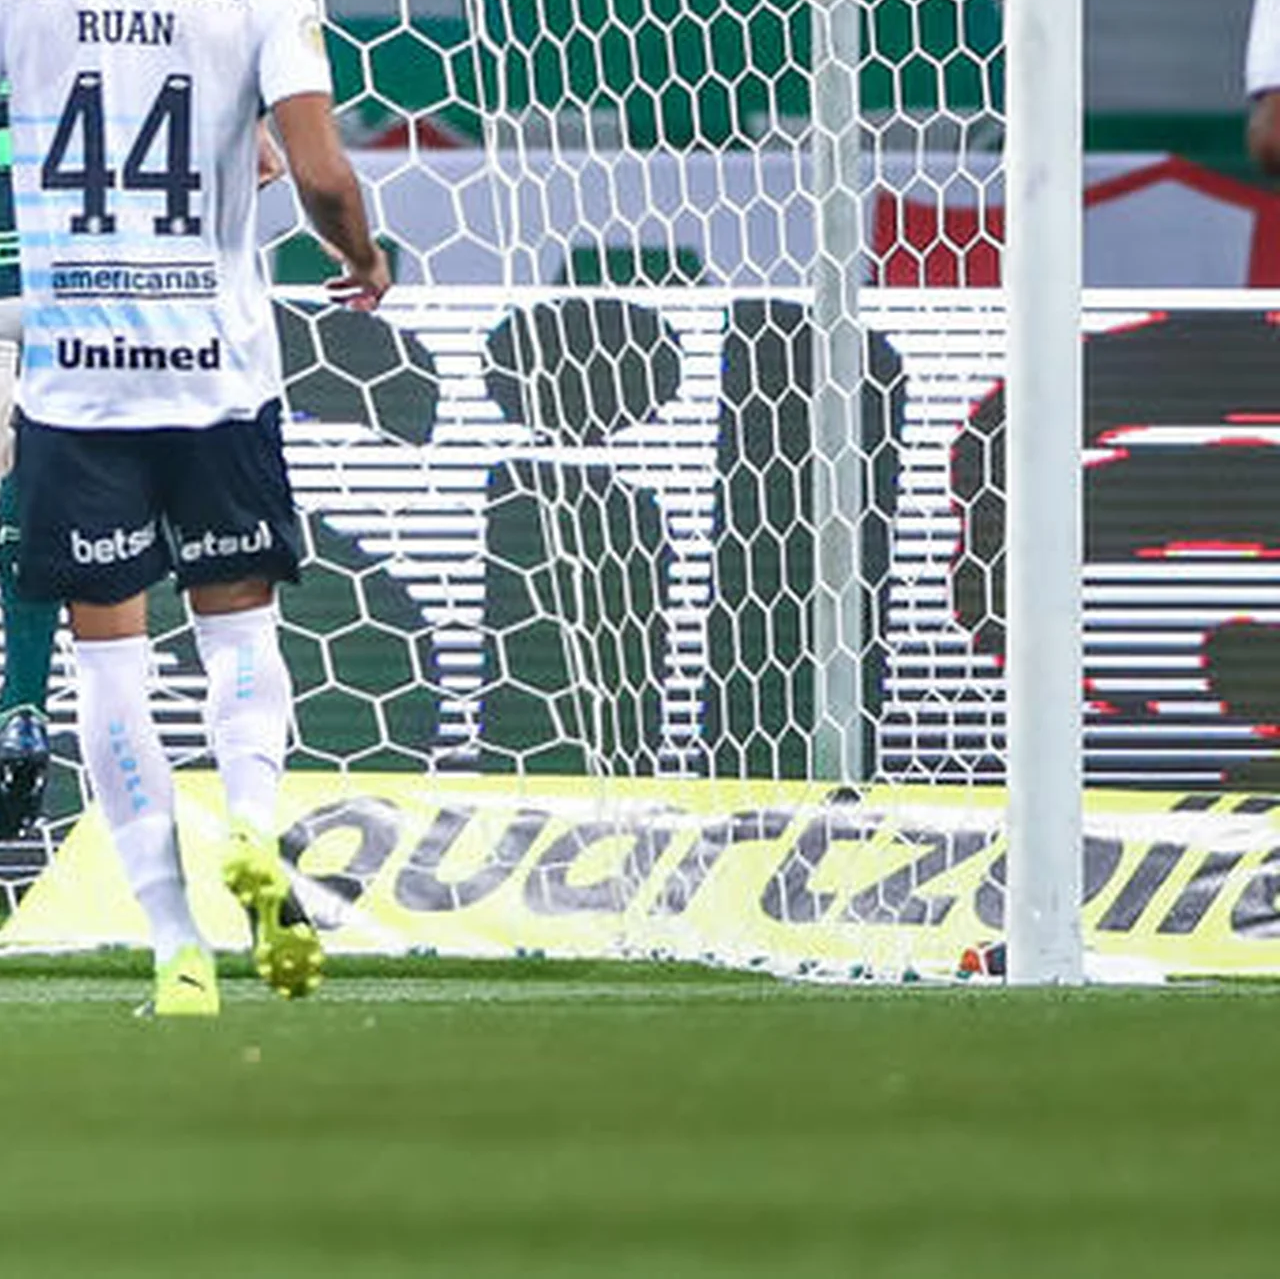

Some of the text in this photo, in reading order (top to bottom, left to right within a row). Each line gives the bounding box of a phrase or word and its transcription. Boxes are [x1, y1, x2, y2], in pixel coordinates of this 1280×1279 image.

[77, 9, 176, 46] RUAN
[40, 71, 204, 236] 44
[52, 269, 219, 290] americanas
[56, 335, 221, 371] Unimed
